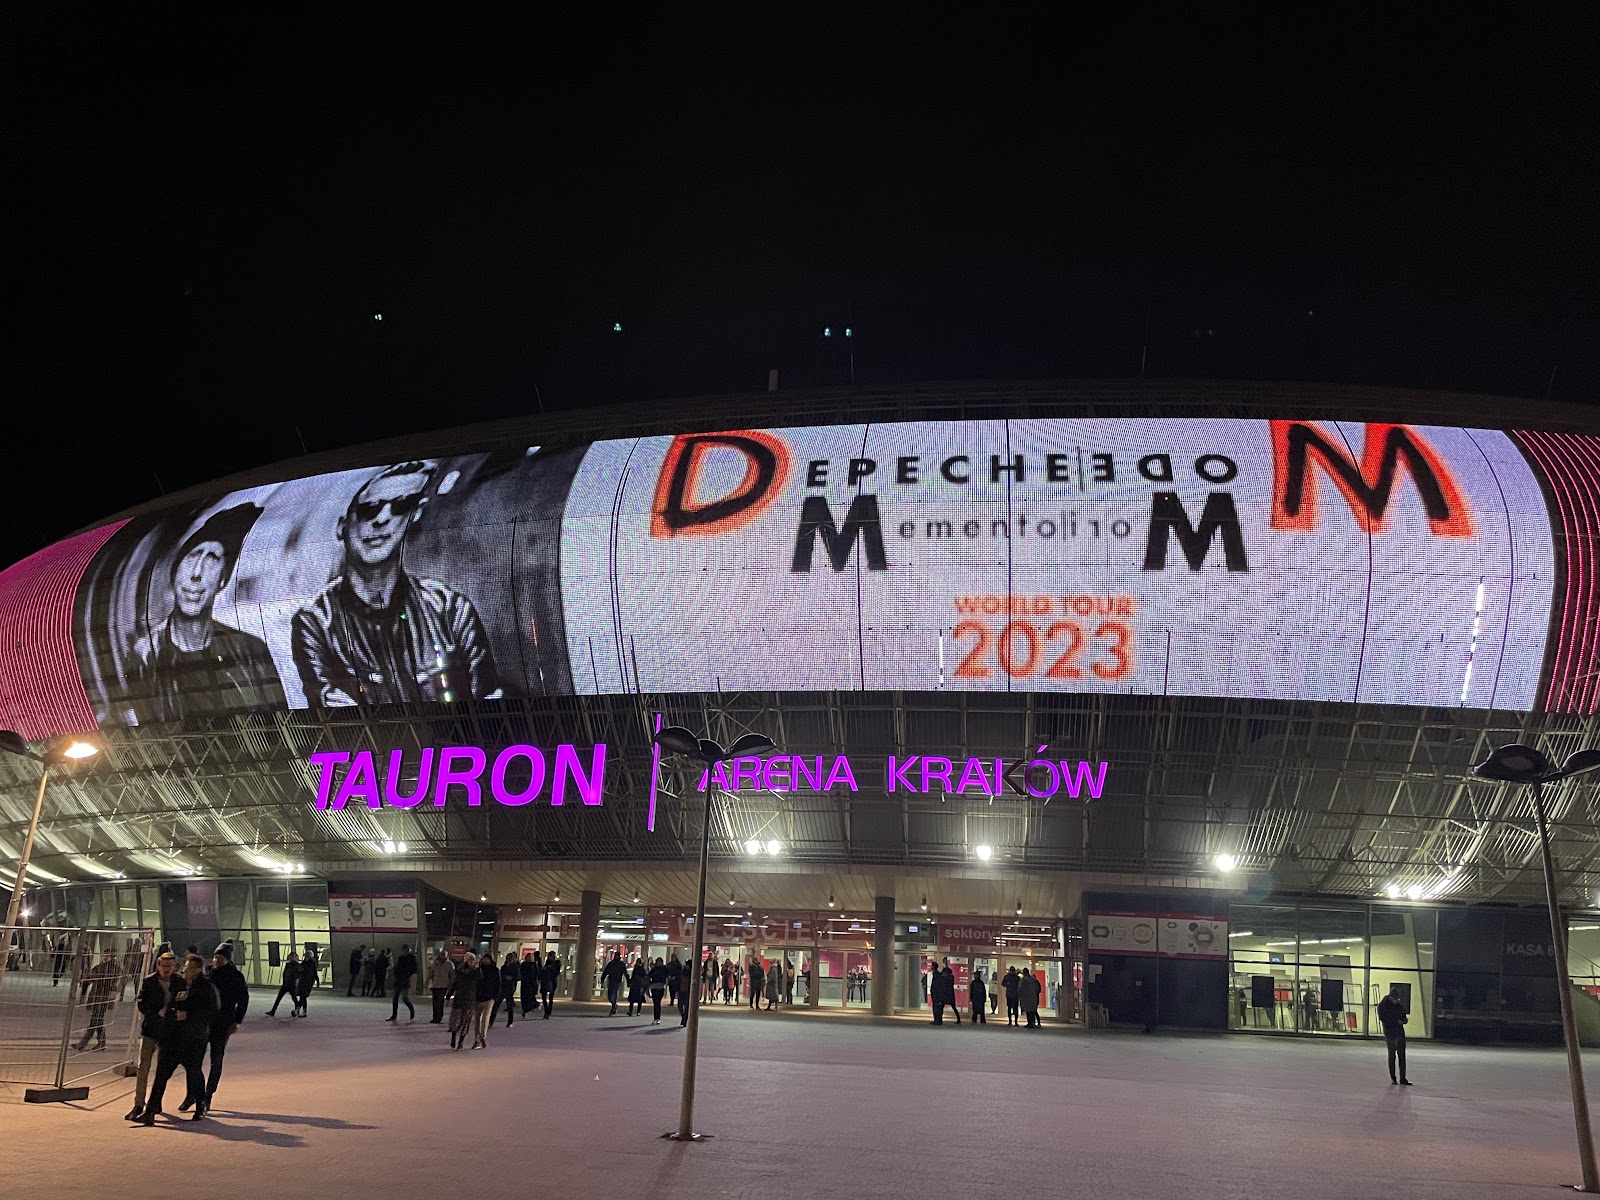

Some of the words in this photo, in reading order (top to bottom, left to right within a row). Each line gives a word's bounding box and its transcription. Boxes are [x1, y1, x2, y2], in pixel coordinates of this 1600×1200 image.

[954, 592, 1053, 615] WORLD
[1060, 594, 1136, 616] TOUR
[952, 620, 1132, 679] 2023
[310, 743, 607, 810] TAURON
[697, 754, 859, 792] ARENA
[887, 744, 1109, 799] KRAKÓW
[944, 926, 995, 943] sektory
[1506, 943, 1545, 957] KASA
